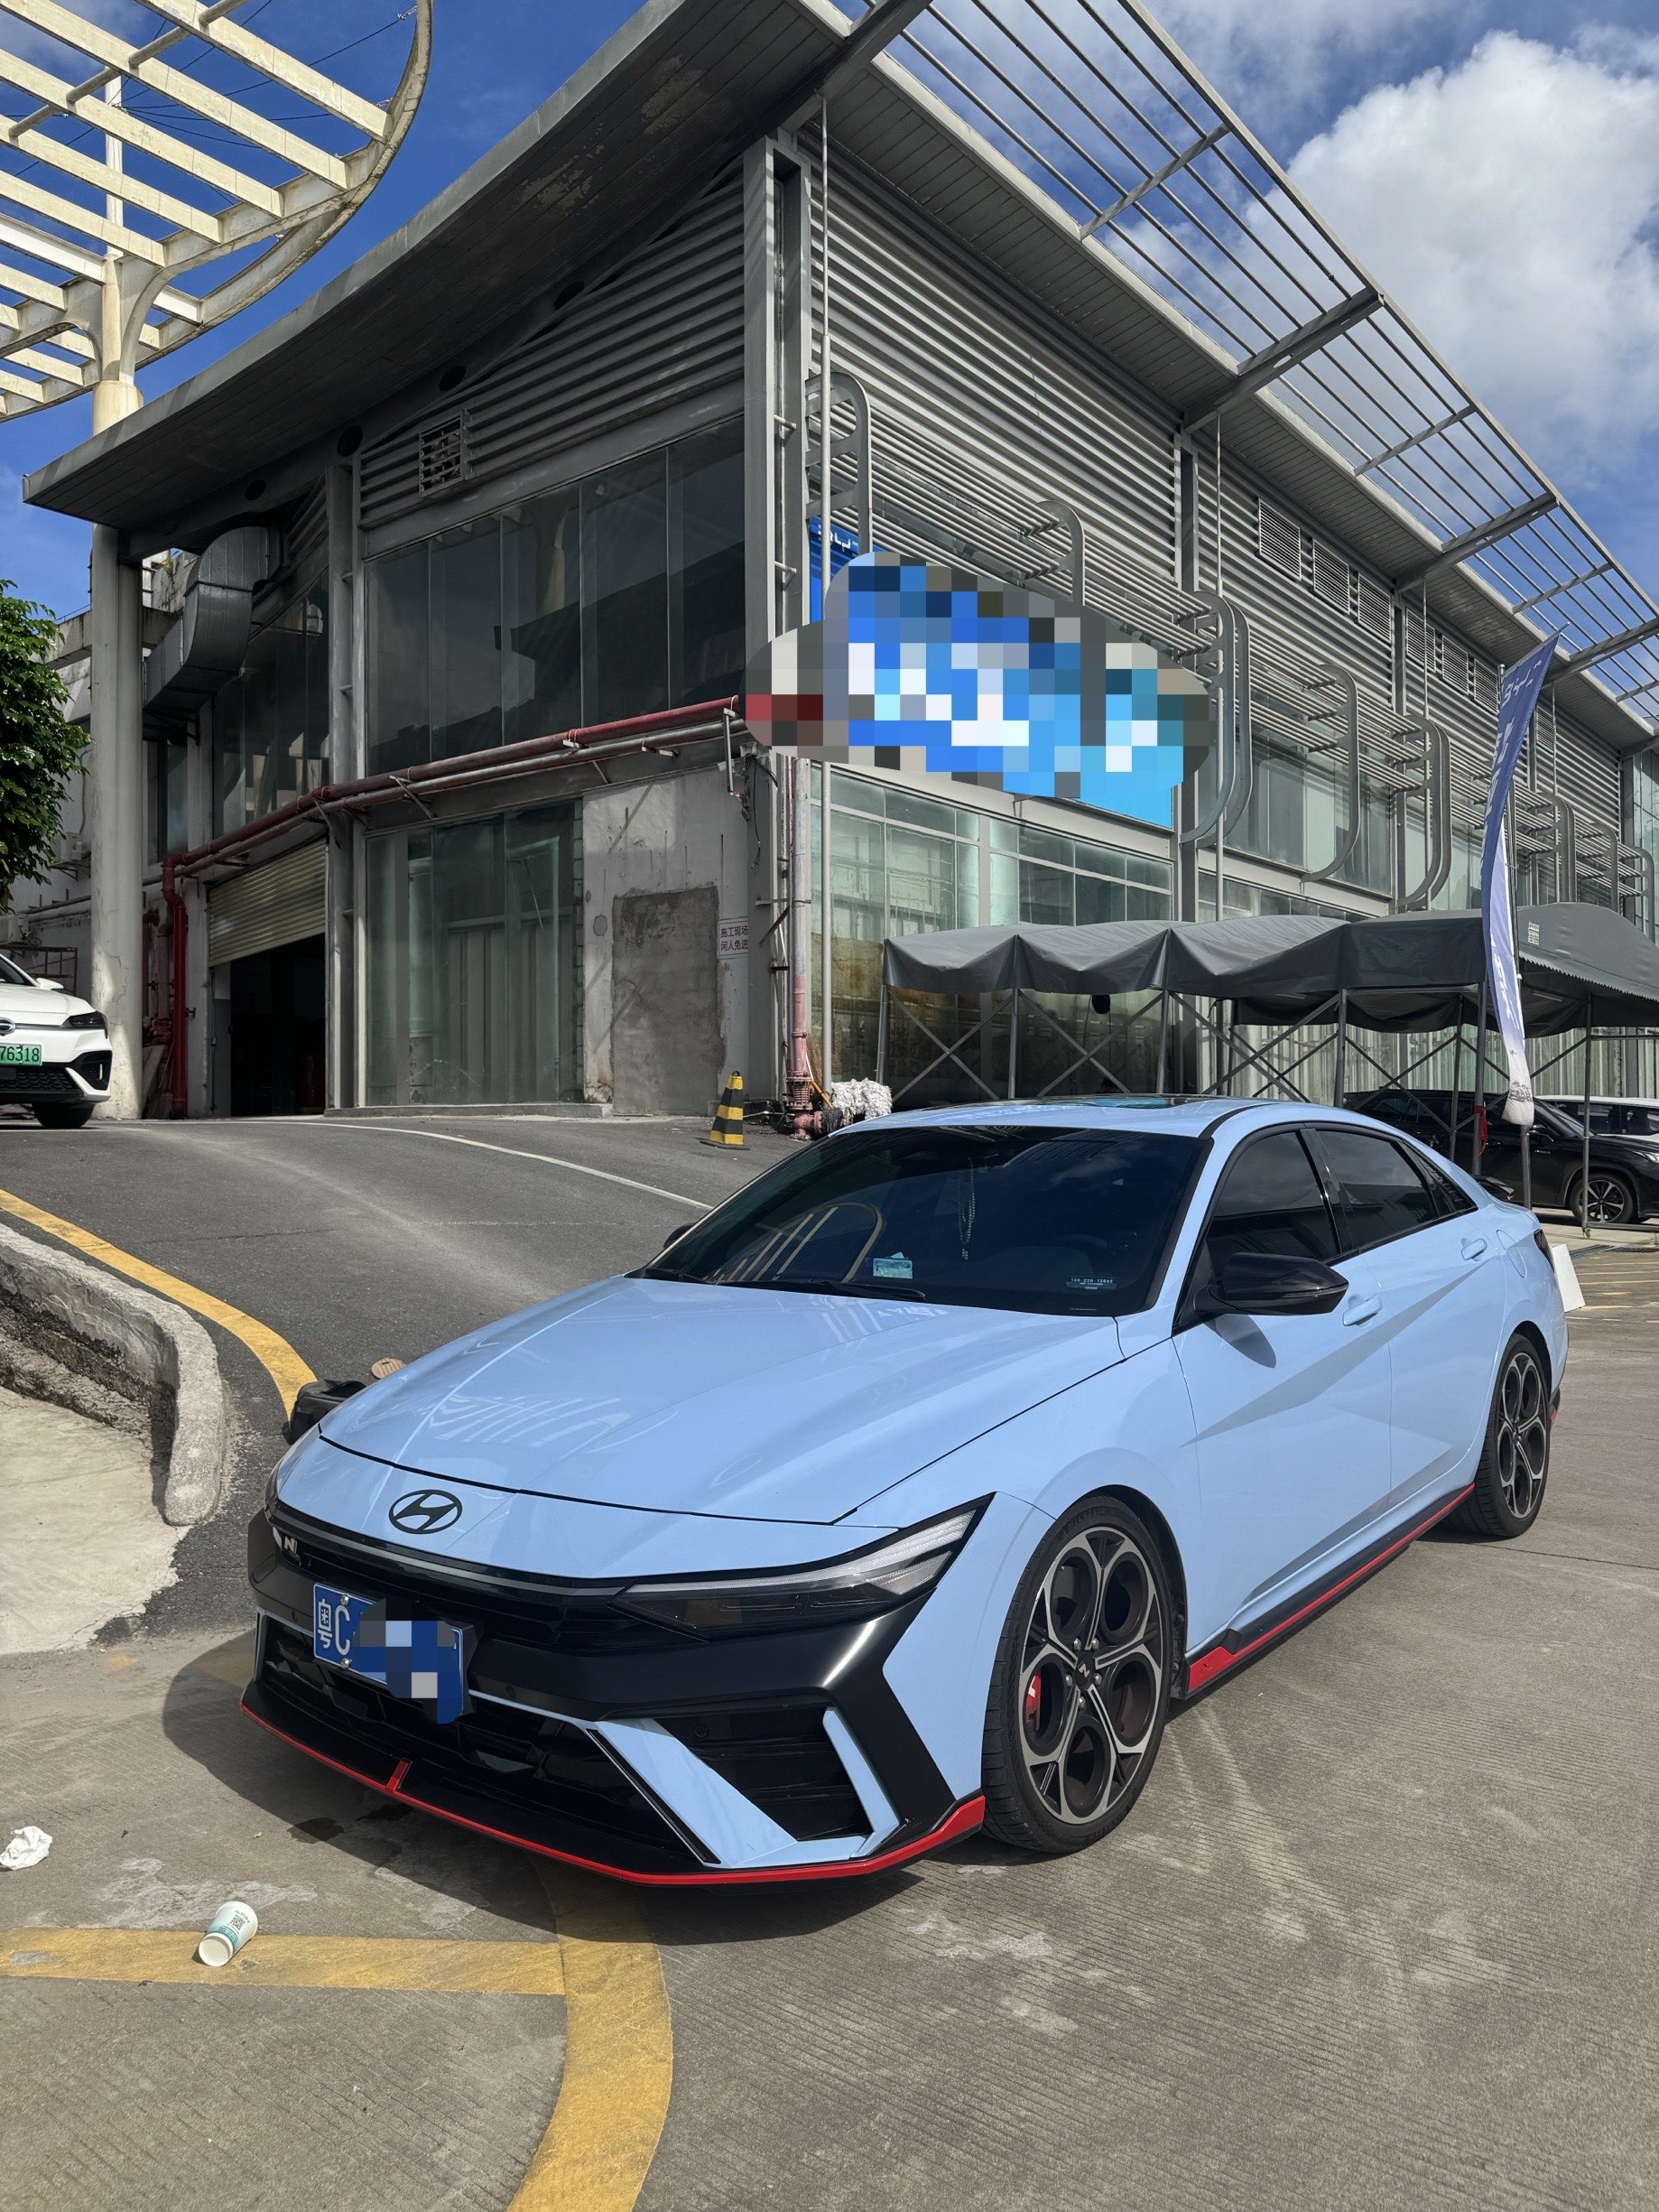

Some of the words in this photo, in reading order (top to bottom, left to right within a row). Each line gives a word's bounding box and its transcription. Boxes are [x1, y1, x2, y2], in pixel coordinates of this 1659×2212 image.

[720, 925, 748, 938] 施工现场
[0, 1046, 40, 1062] 76318
